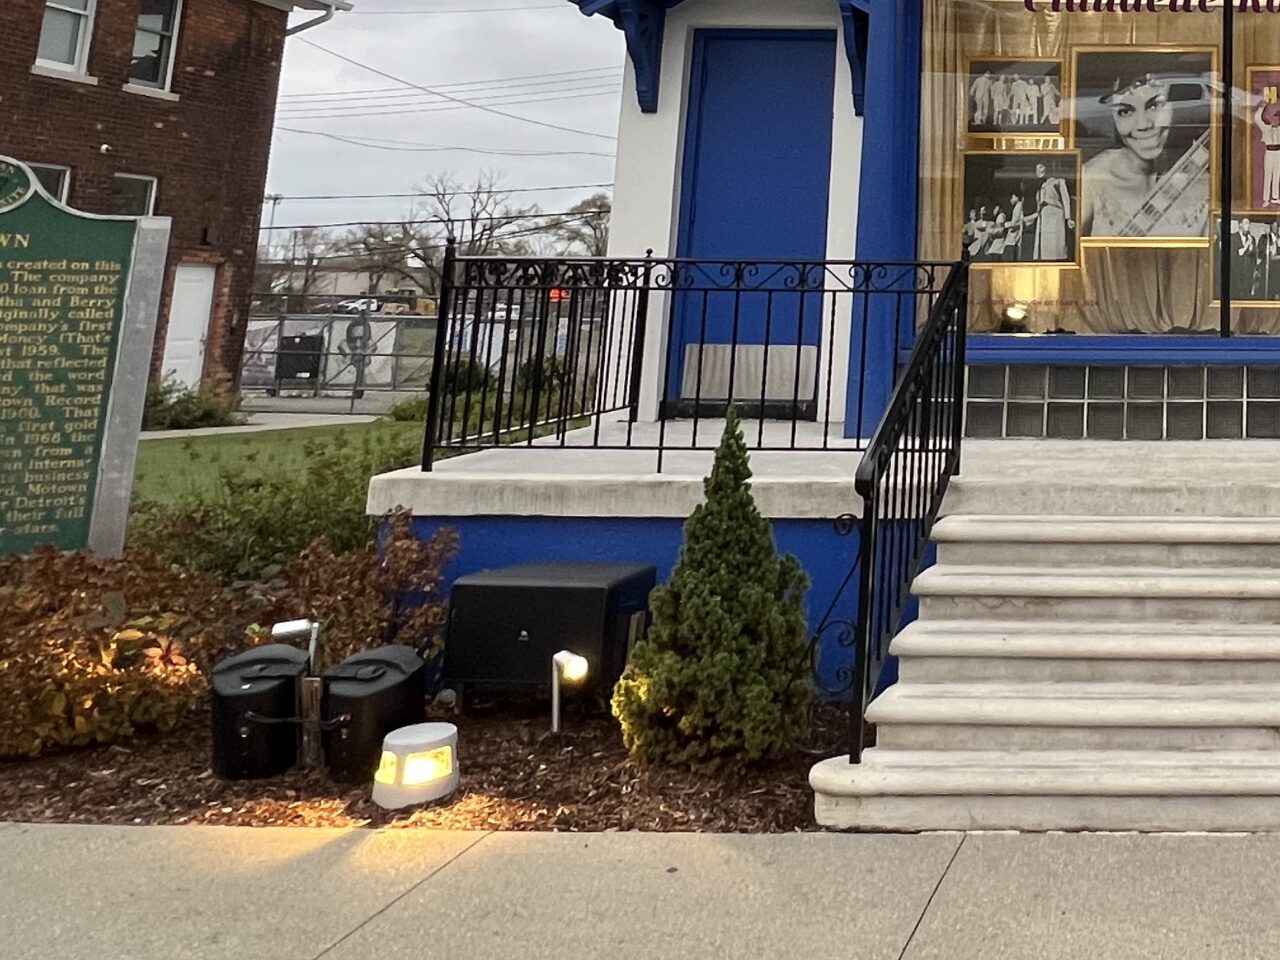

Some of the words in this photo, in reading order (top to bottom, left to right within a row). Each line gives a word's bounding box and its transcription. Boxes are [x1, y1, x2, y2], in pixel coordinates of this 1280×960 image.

[7, 260, 67, 270] created
[70, 261, 90, 270] on
[95, 260, 121, 270] this
[10, 271, 42, 281] The
[49, 274, 120, 285] company
[13, 283, 47, 294] loan
[53, 284, 89, 294] from
[94, 285, 118, 294] the
[32, 297, 61, 307] and
[70, 295, 116, 309] Berry
[68, 308, 114, 319] called
[79, 321, 113, 331] first
[79, 344, 109, 355] The
[37, 357, 107, 369] reflected
[28, 370, 53, 381] the
[67, 370, 105, 380] word
[34, 383, 67, 393] that
[76, 384, 104, 392] was
[45, 394, 102, 406] Record
[62, 406, 99, 418] That
[19, 421, 55, 432] first
[64, 419, 98, 433] gold
[34, 445, 73, 457] from
[25, 471, 90, 483] business
[28, 483, 87, 495] Motown
[16, 495, 86, 508] Detroit's
[6, 510, 47, 521] their
